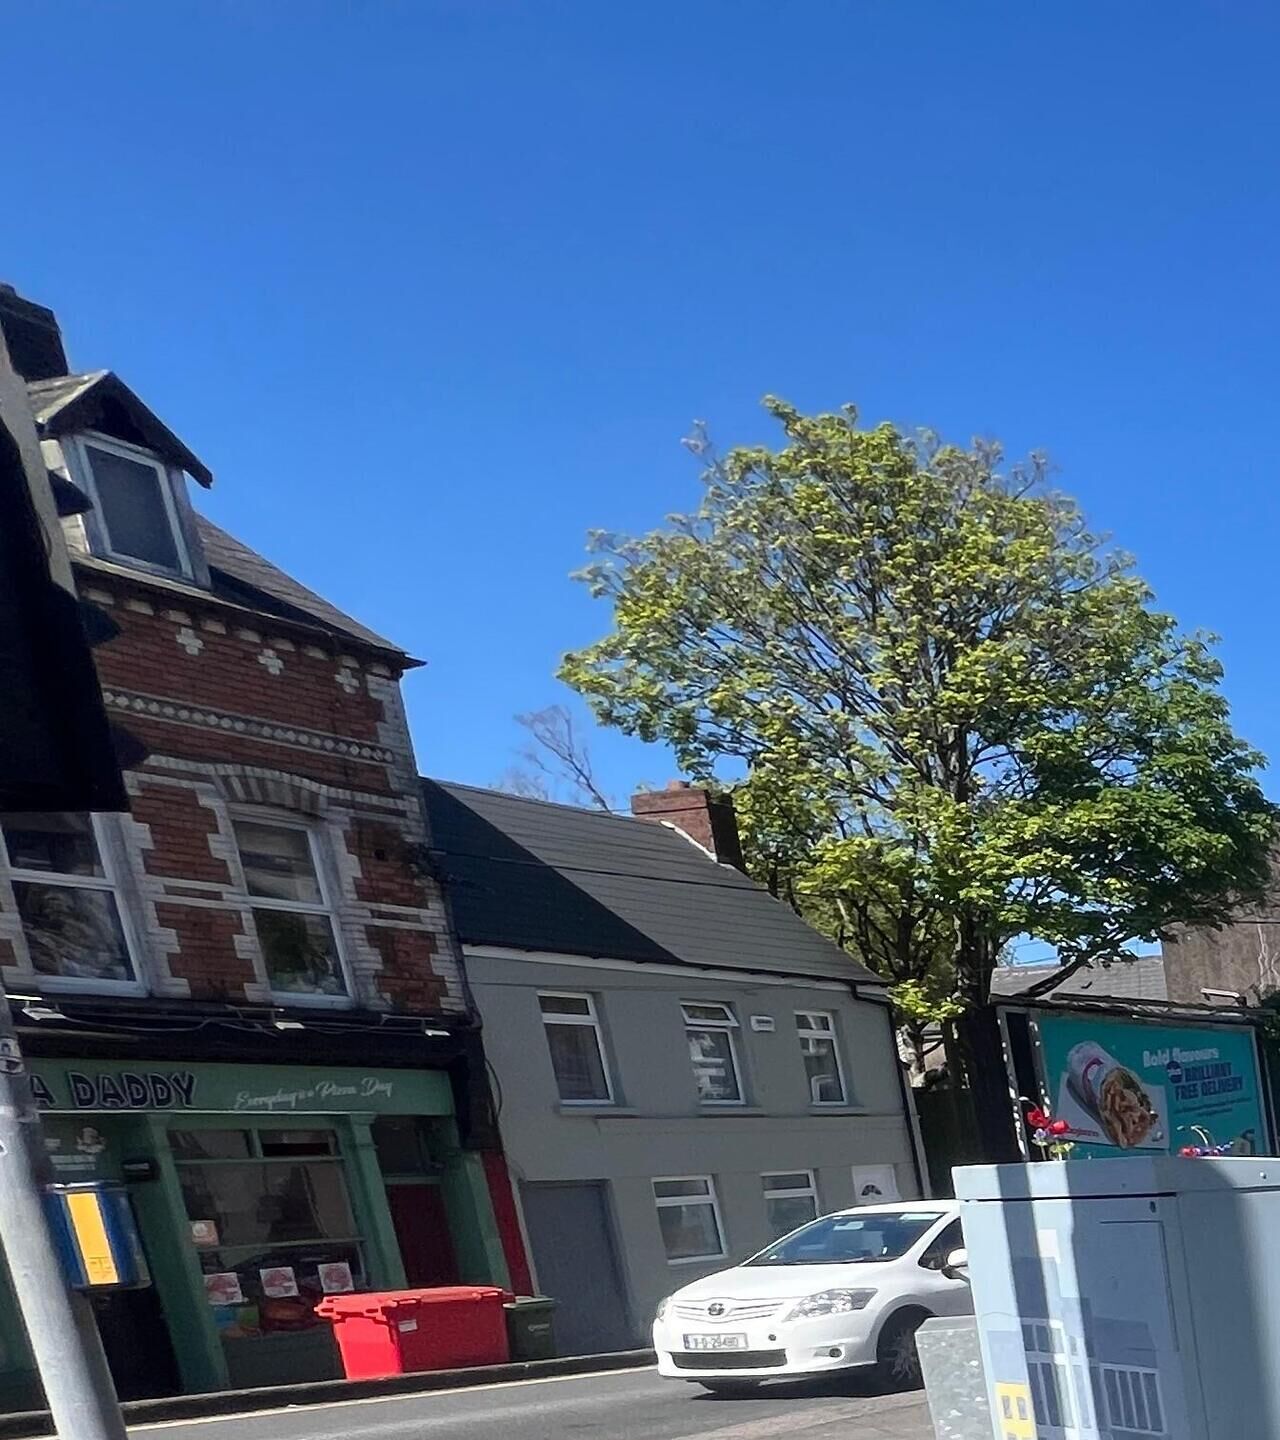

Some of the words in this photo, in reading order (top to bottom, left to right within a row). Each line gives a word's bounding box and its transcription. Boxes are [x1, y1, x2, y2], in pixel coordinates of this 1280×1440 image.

[1143, 1049, 1169, 1068] Bold
[1172, 1047, 1219, 1063] flavours
[1184, 1061, 1232, 1082] BRILLIANT
[68, 1069, 198, 1109] DADDY
[361, 1076, 393, 1099] Day
[1175, 1082, 1199, 1100] FREE
[1201, 1076, 1244, 1097] DELIVERY
